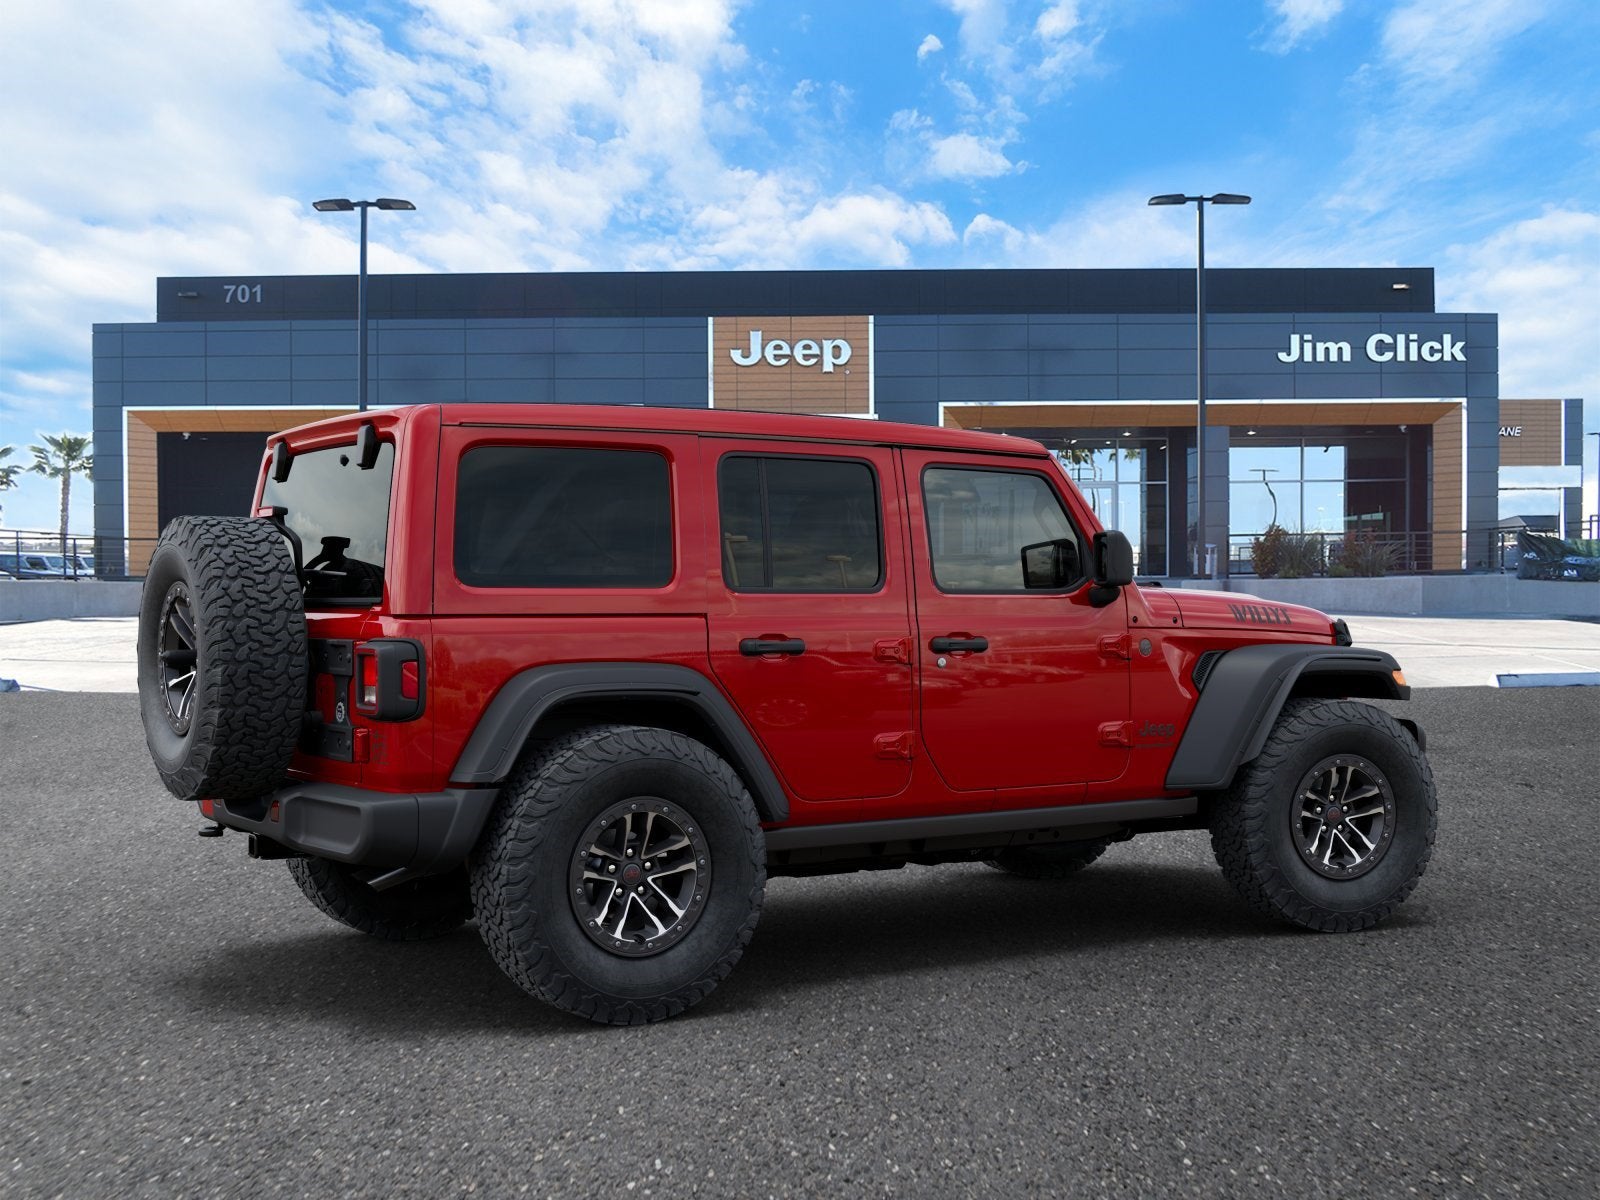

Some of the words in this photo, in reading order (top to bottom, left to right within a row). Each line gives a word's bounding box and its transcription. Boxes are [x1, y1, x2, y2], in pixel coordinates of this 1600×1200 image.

[223, 284, 262, 304] 701
[729, 330, 852, 373] Jeep
[1277, 333, 1351, 363] Jim
[1366, 333, 1467, 363] Click
[1227, 603, 1292, 624] WILLYS
[1139, 719, 1175, 739] Jeep
